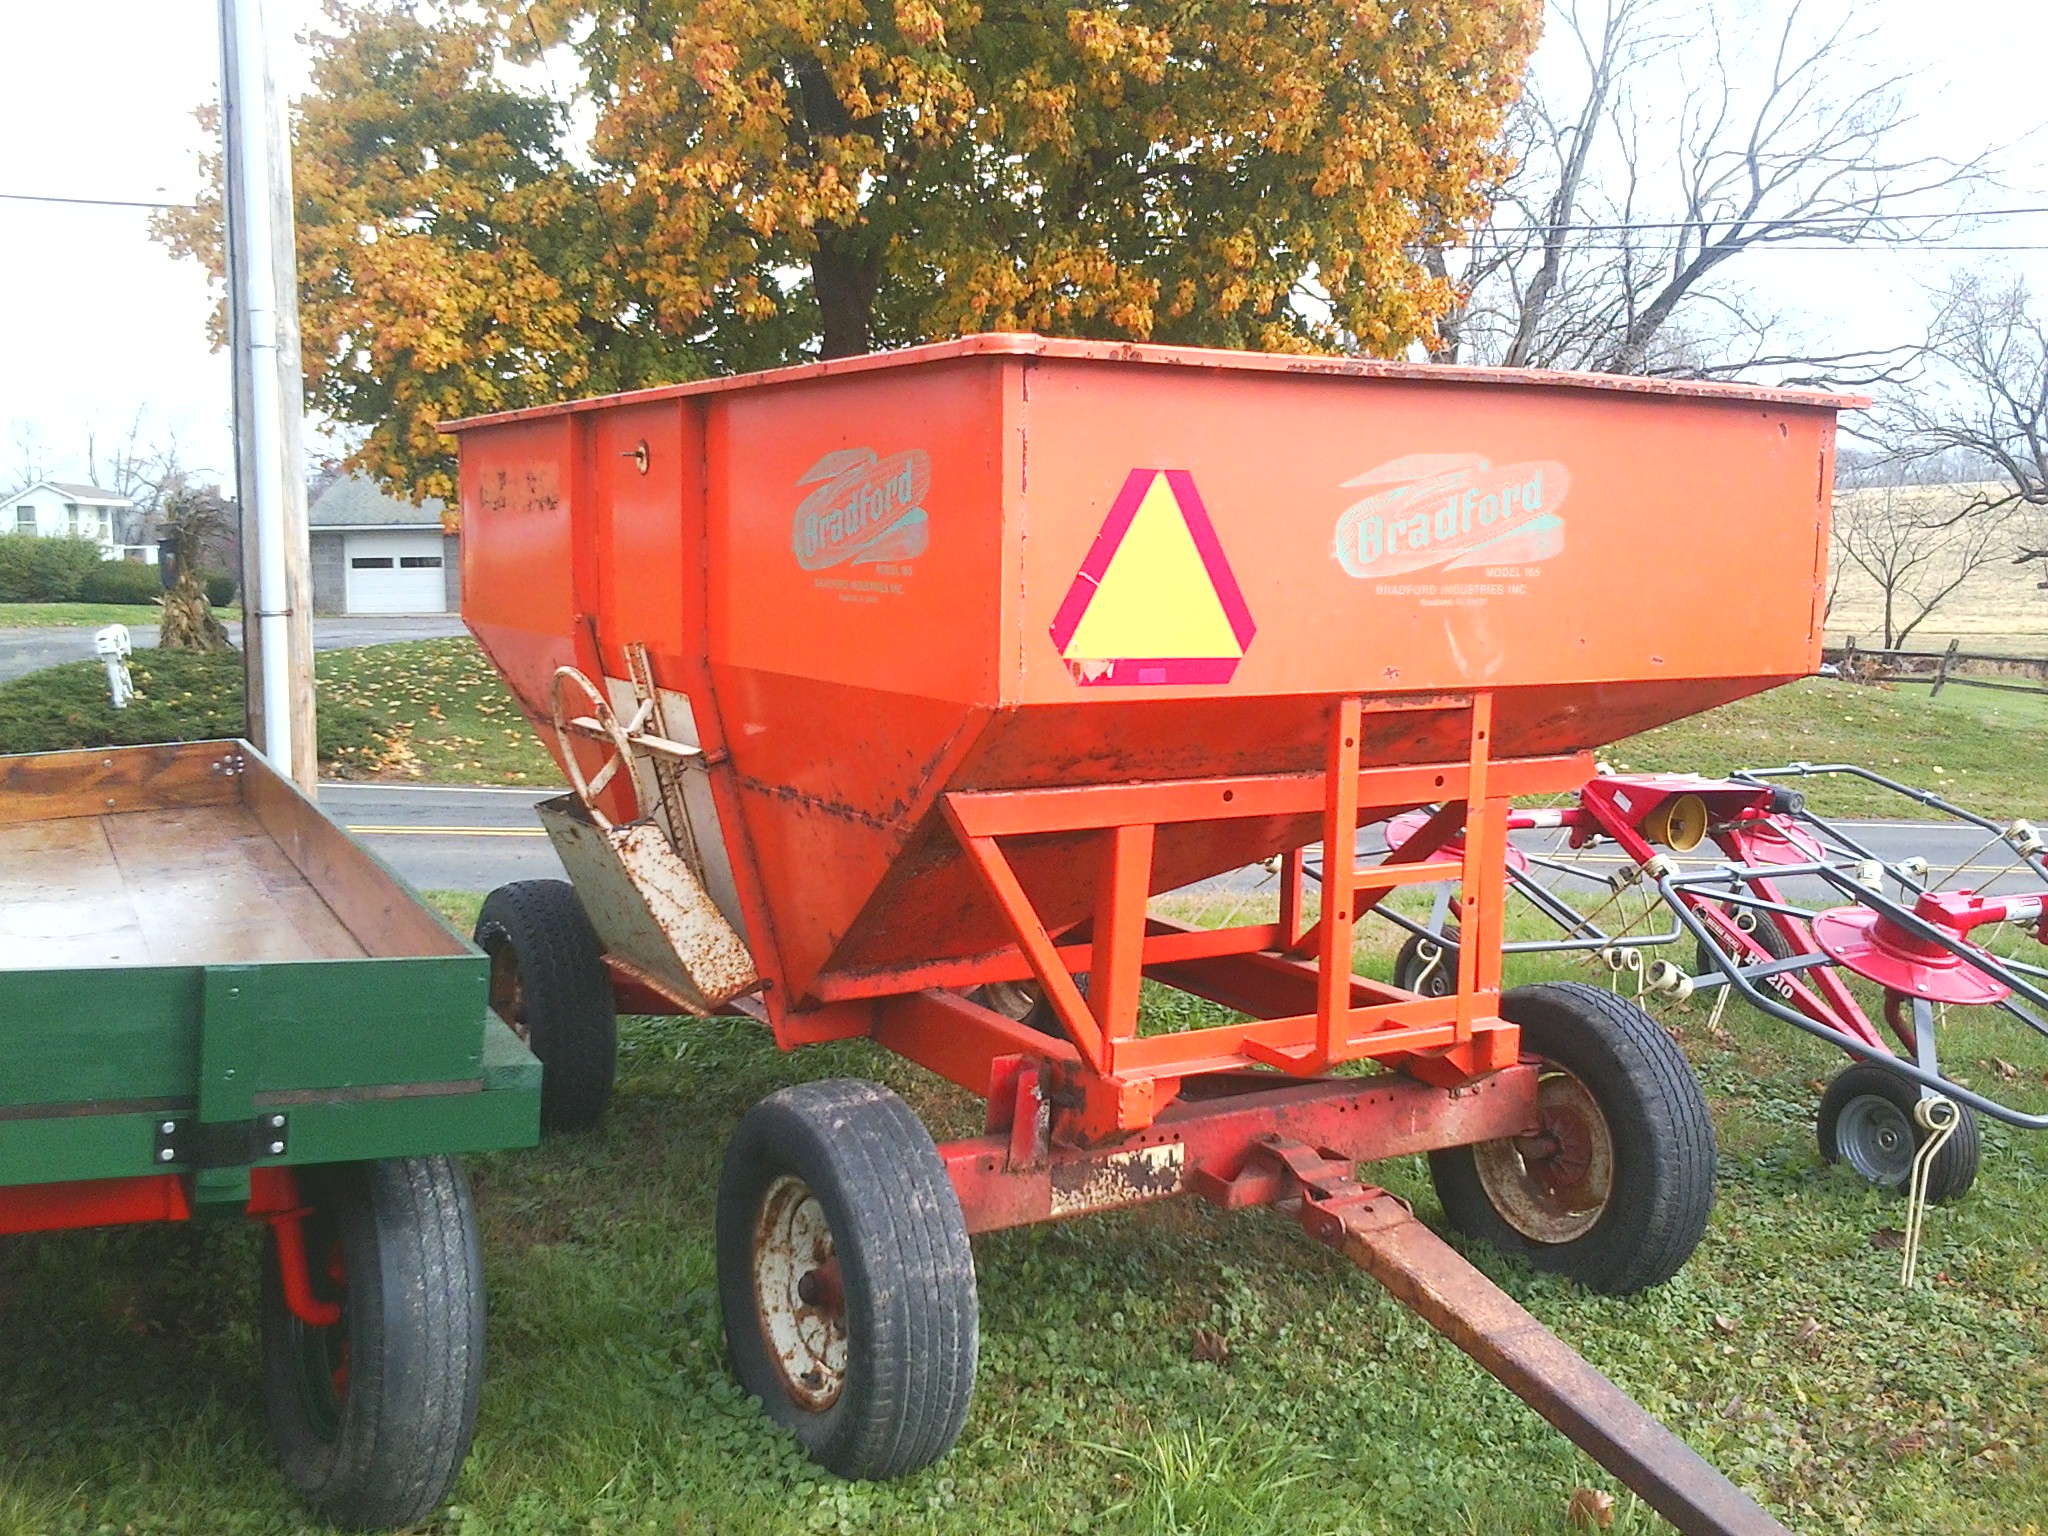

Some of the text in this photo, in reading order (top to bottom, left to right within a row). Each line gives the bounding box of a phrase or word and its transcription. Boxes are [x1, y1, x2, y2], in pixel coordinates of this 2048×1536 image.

[803, 458, 913, 558] Bradford
[1356, 469, 1543, 564] Bradford
[1376, 584, 1437, 596] BRADFORD
[1440, 584, 1504, 596] INDUSTRIES
[1485, 567, 1521, 578] MODEL
